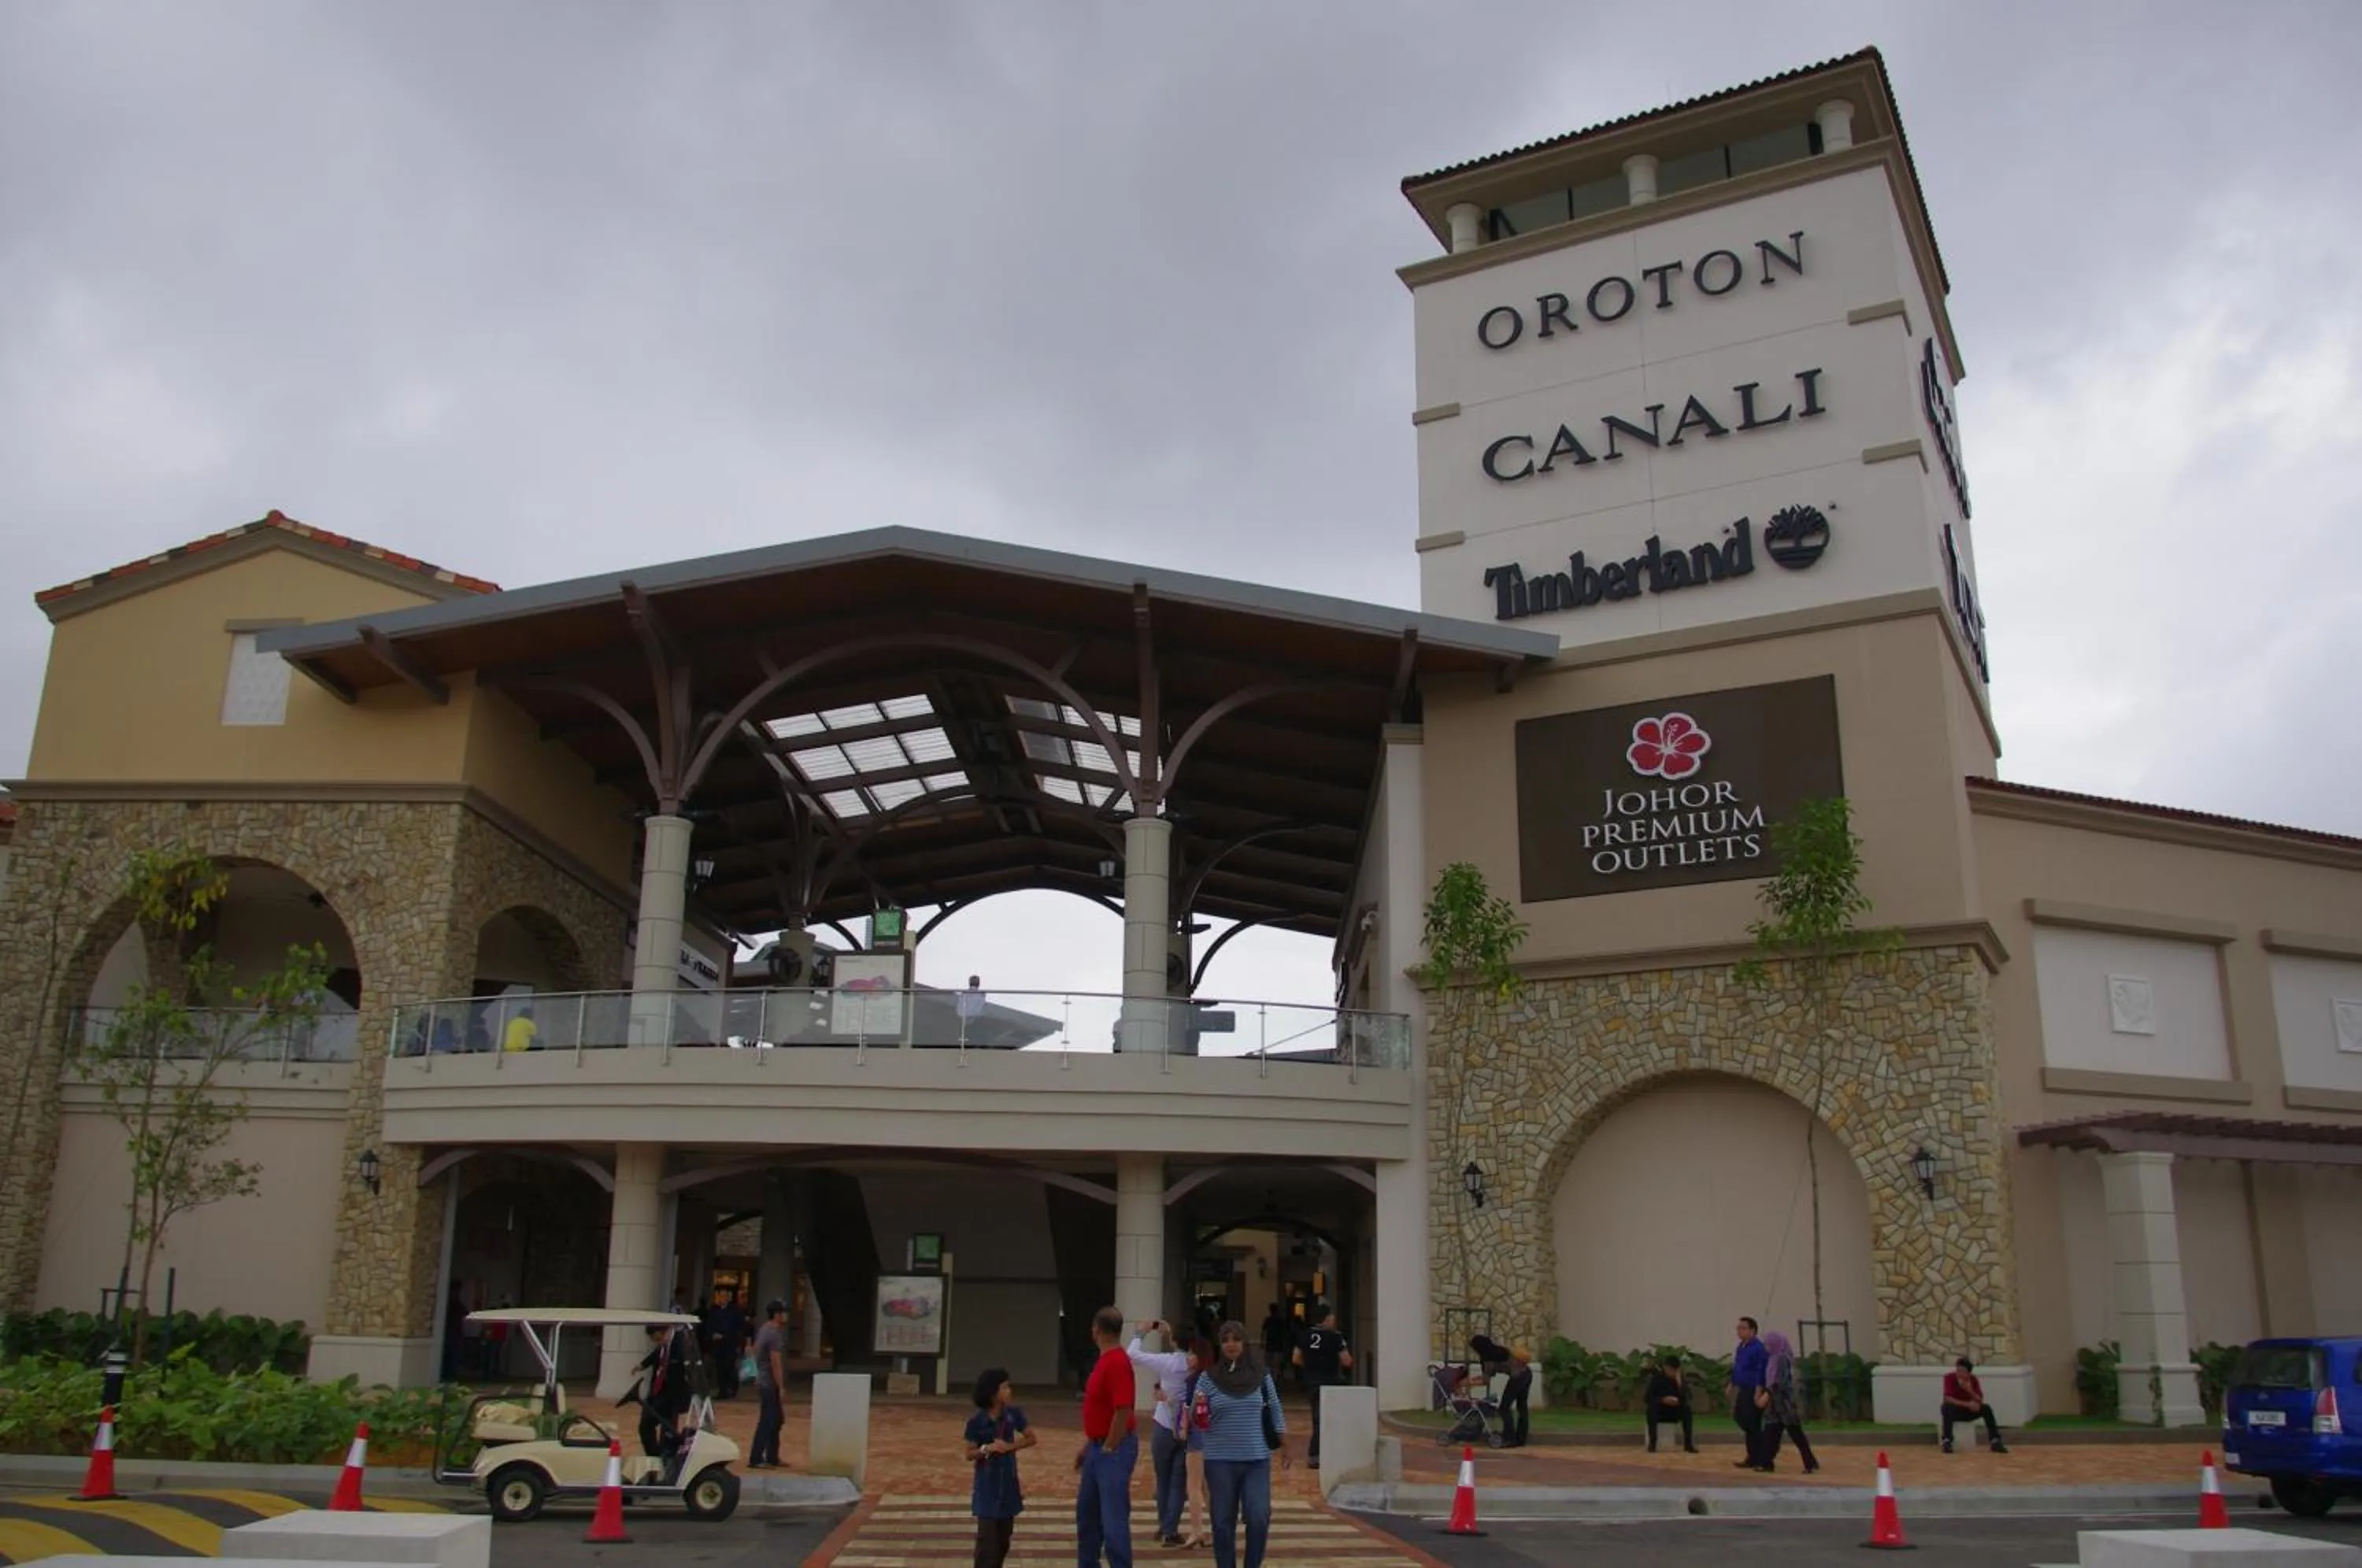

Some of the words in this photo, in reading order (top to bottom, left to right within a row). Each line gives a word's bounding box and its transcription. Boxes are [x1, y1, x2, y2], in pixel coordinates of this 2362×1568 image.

[1477, 231, 1804, 349] OROTON
[1482, 368, 1826, 482] CANALI
[1484, 516, 1755, 620] Timberland
[1602, 780, 1739, 818] JOHOR
[1582, 805, 1766, 849] PREMIUM
[1592, 834, 1761, 874] OUTLETS
[1310, 1333, 1321, 1348] 2
